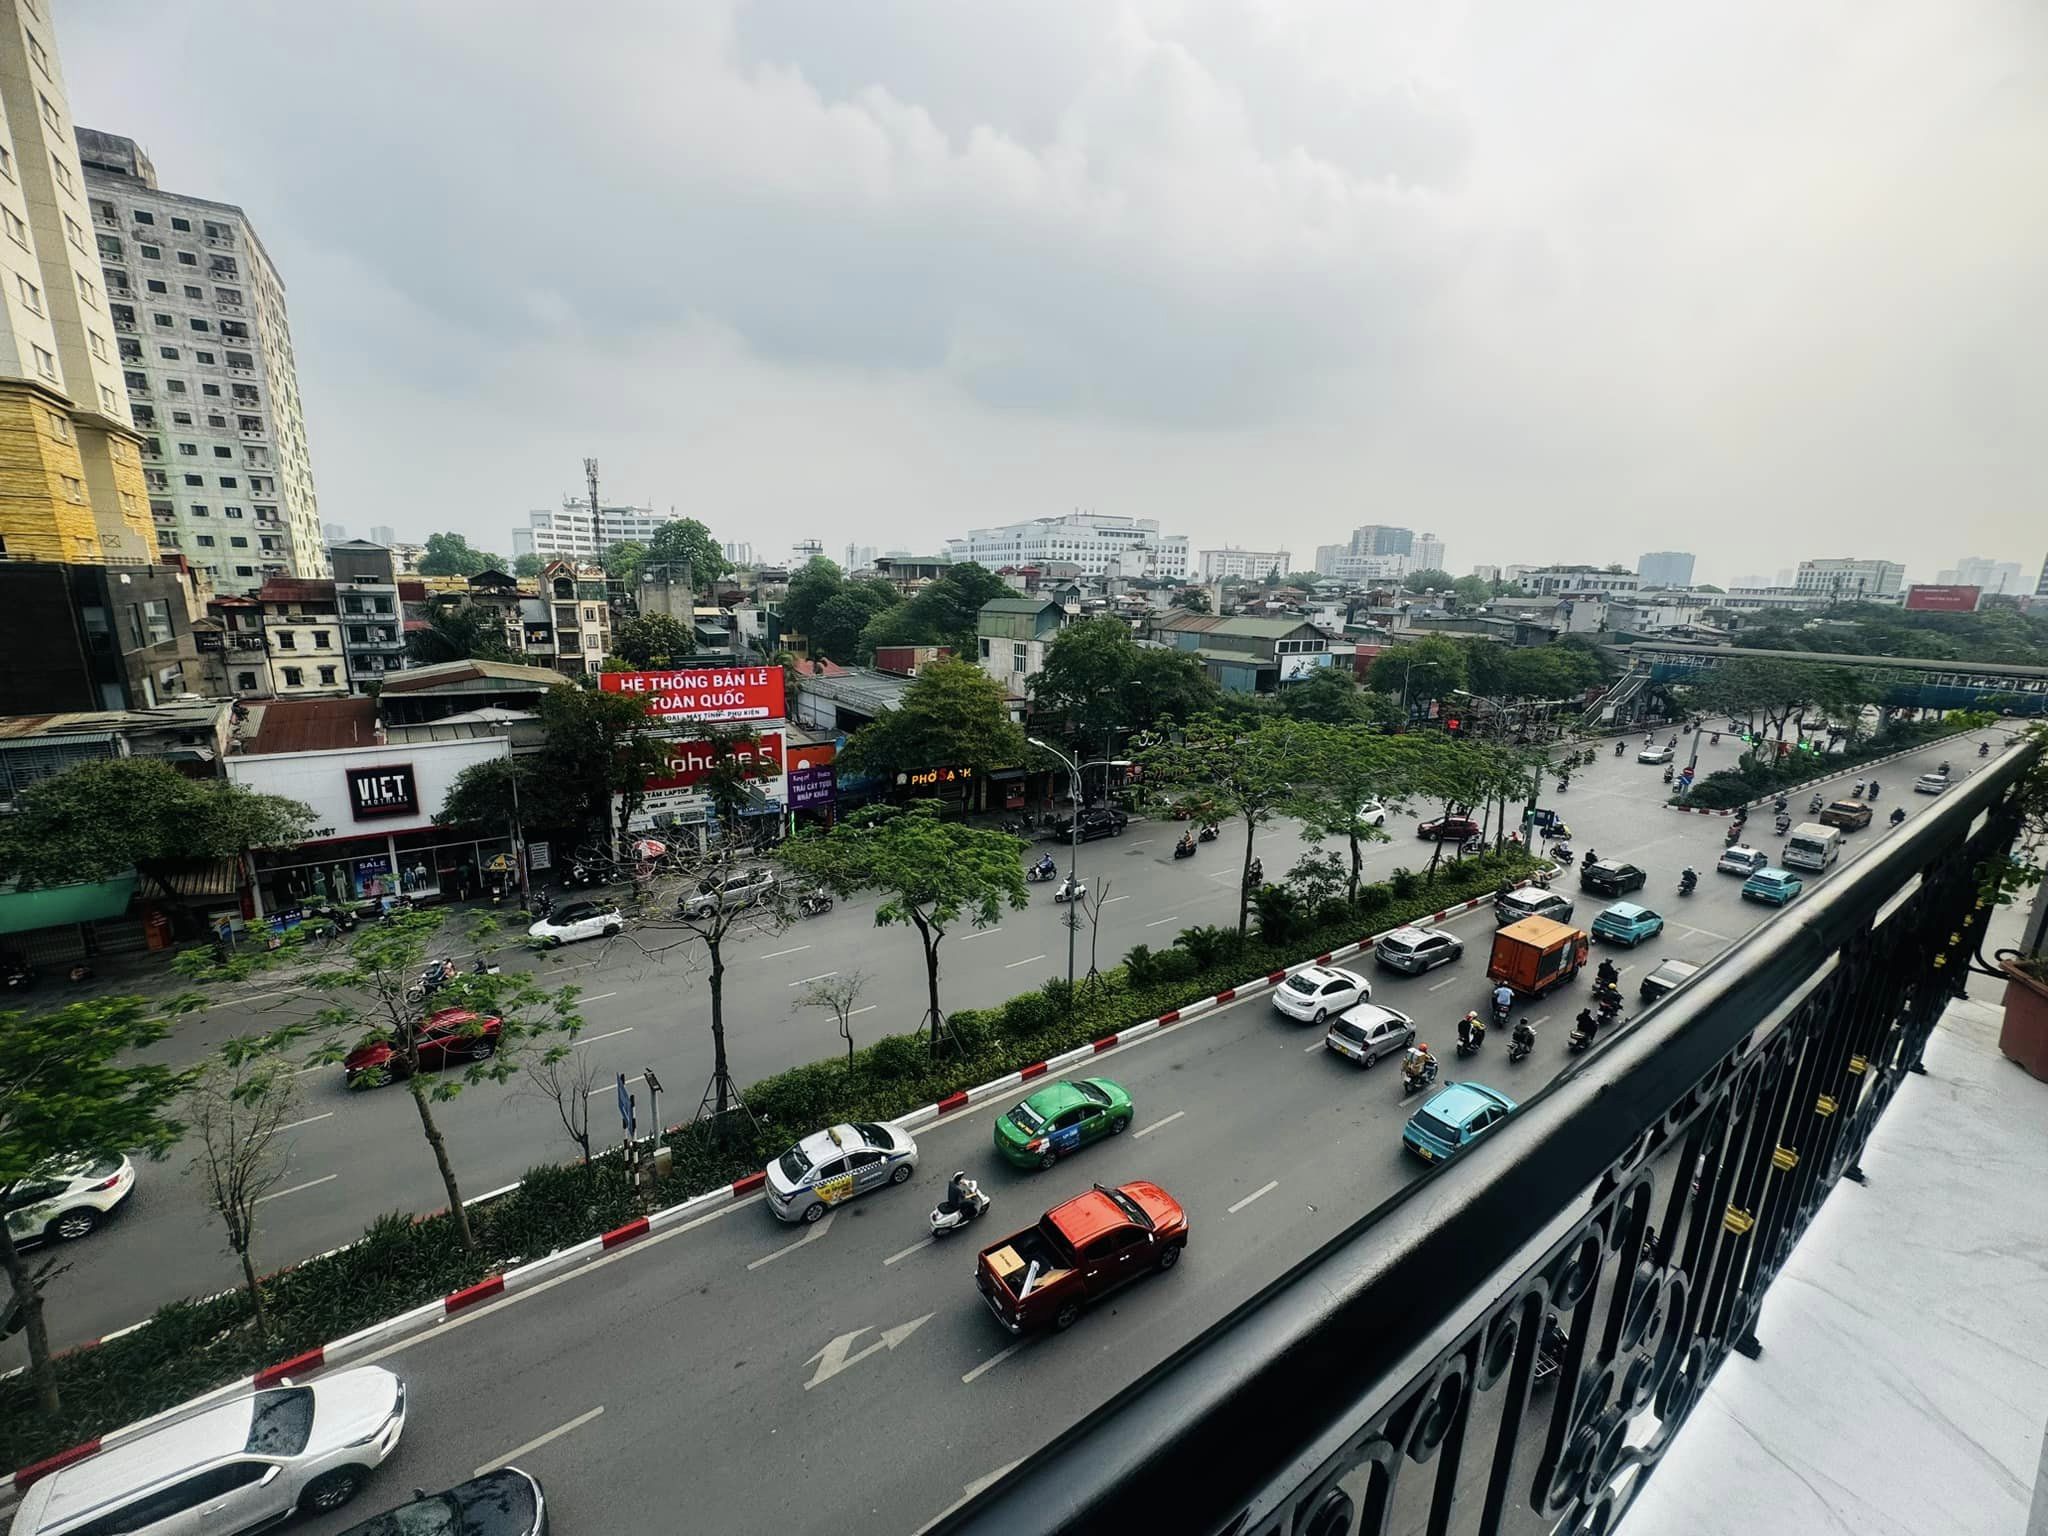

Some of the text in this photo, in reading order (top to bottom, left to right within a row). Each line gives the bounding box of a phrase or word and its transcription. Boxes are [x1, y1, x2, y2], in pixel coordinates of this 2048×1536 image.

[649, 671, 708, 691] THỐNG
[713, 672, 746, 688] BÁN
[750, 669, 769, 686] LẺ
[650, 688, 745, 710] TOÀN QUỐC
[911, 768, 937, 785] PHỞ
[359, 860, 386, 869] SALE
